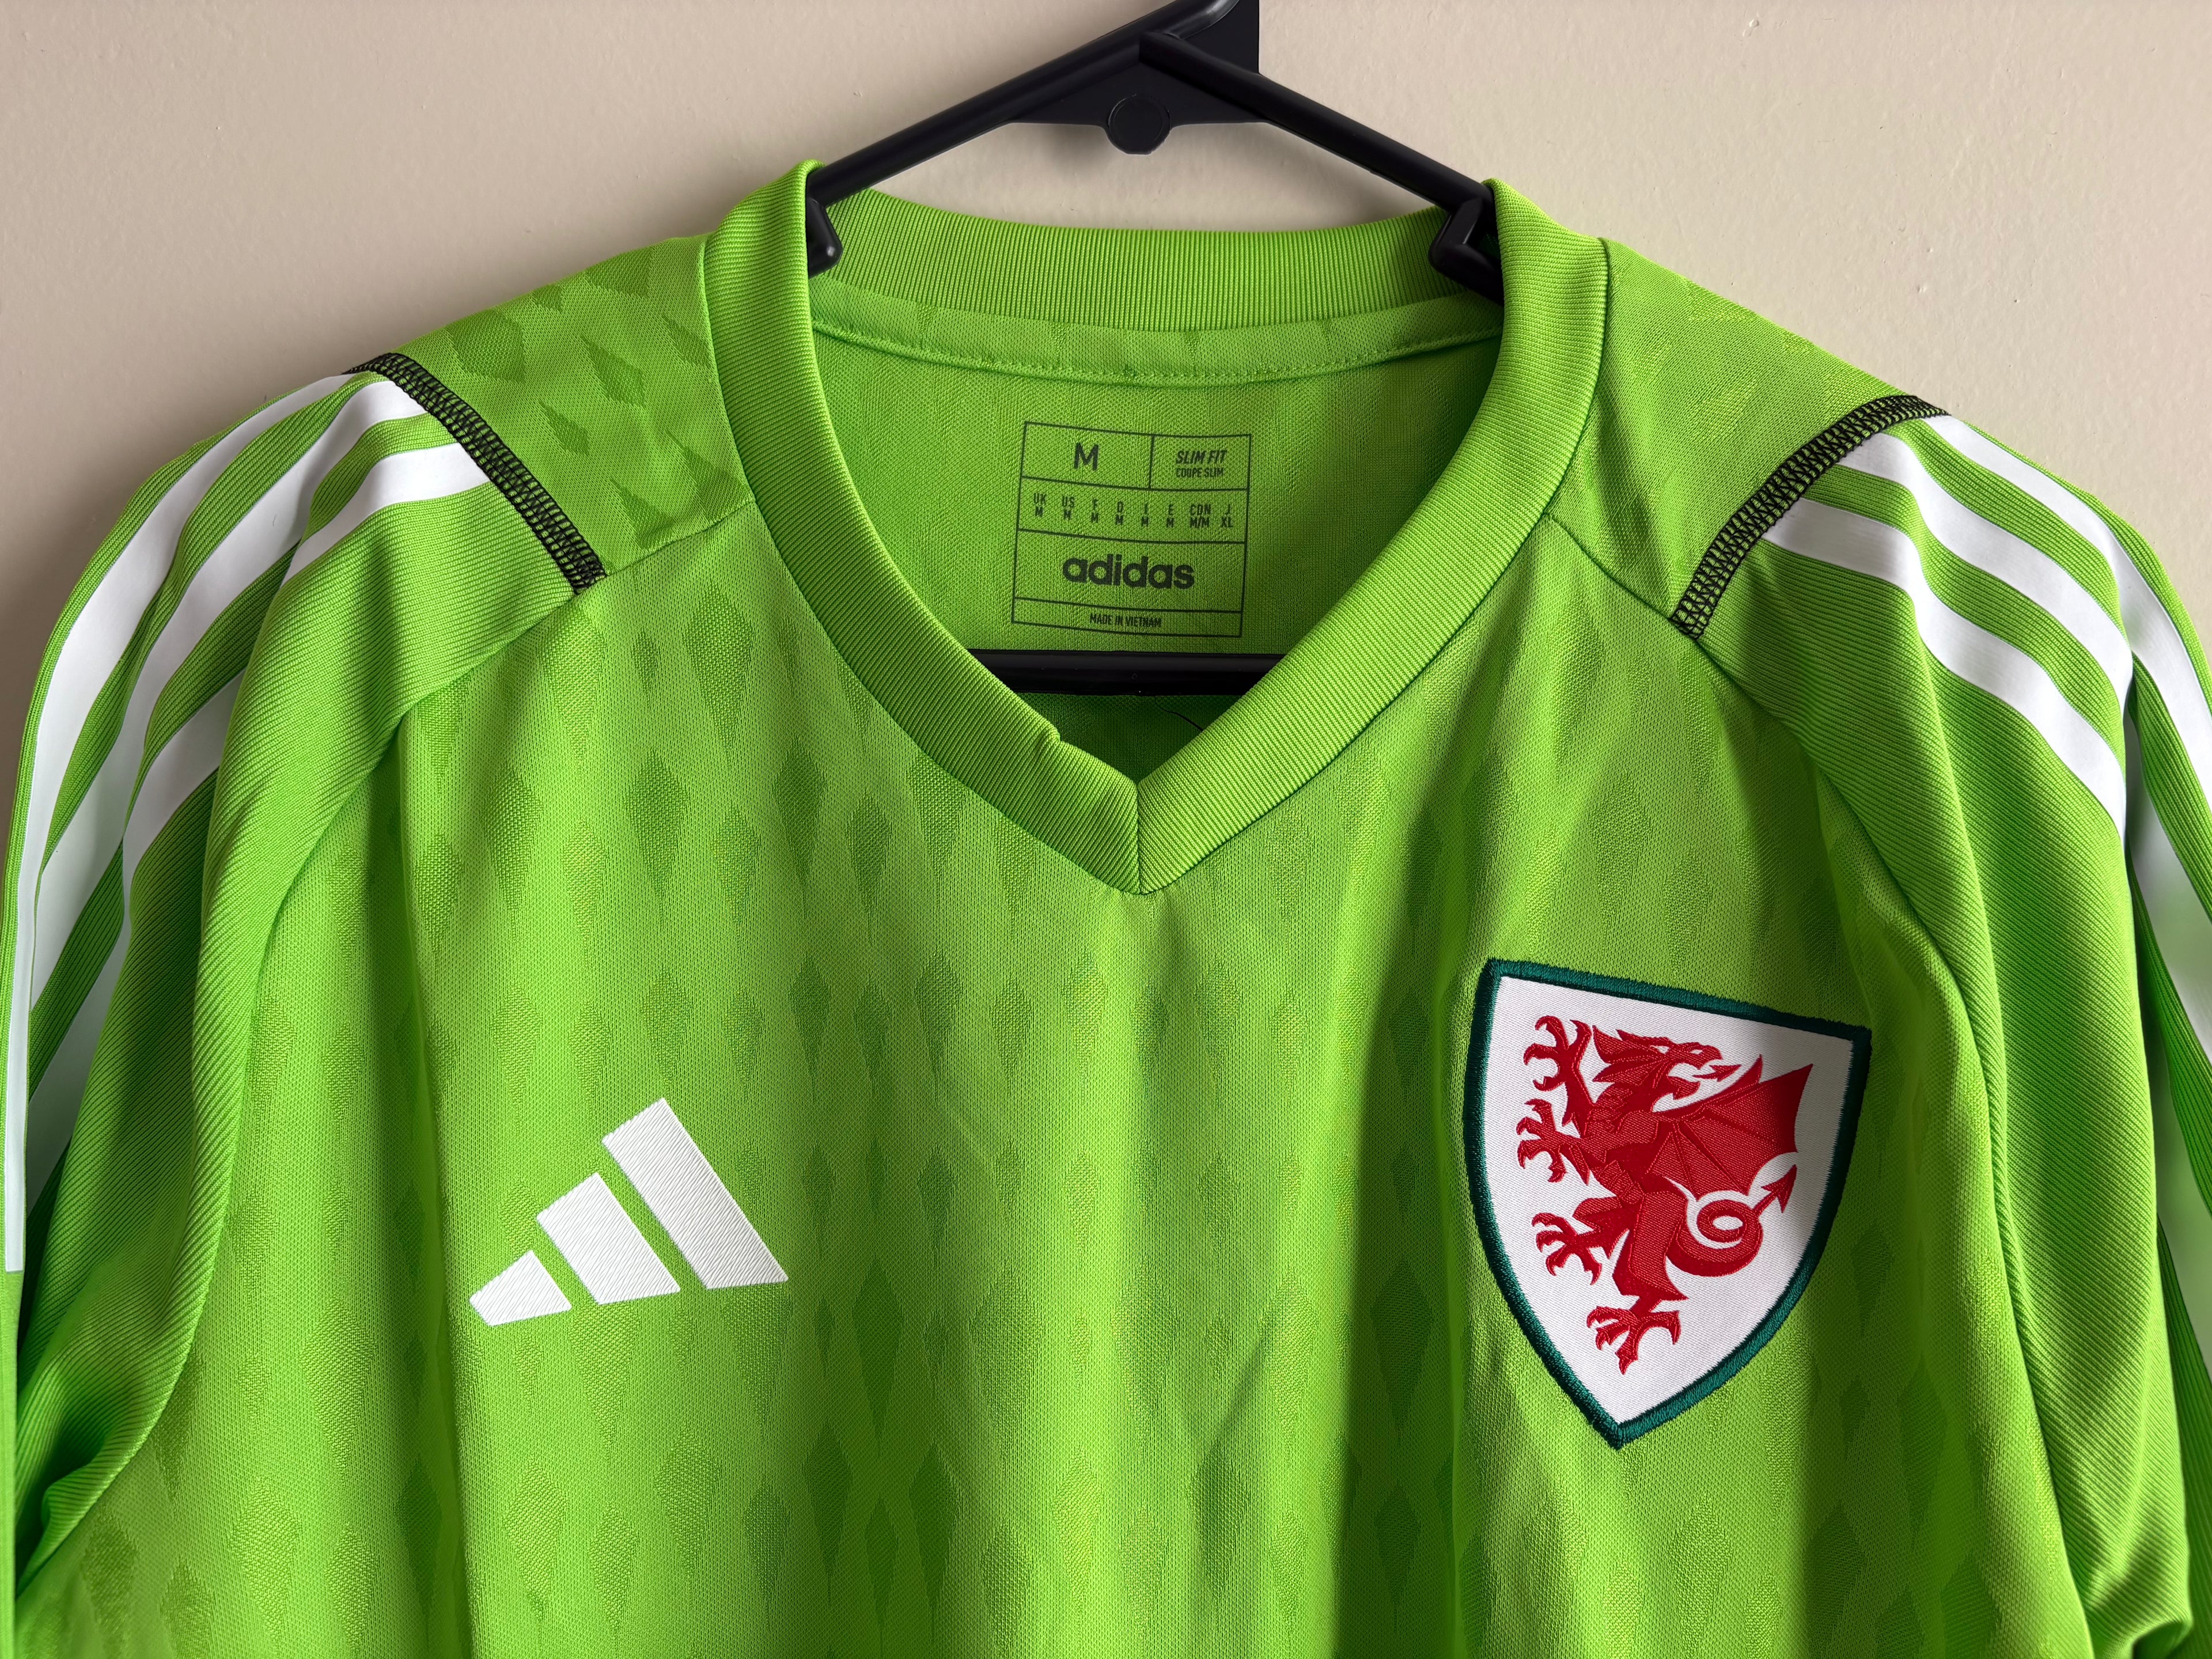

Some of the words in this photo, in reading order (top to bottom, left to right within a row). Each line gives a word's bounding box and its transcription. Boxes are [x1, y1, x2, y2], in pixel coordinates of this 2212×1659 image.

[1073, 443, 1099, 470] M
[1176, 450, 1205, 463] SLIM
[1208, 450, 1226, 463] FIT
[1176, 468, 1202, 478] COUPE
[1205, 468, 1224, 476] SLIM
[1034, 493, 1046, 505] UK
[1062, 496, 1074, 507] US
[1093, 499, 1099, 510] F
[1169, 505, 1173, 516] E
[1035, 506, 1043, 517] M
[1063, 510, 1071, 520] M
[1091, 513, 1099, 523] M
[1116, 514, 1123, 525] M
[1141, 516, 1149, 527] M
[1166, 517, 1174, 528] M
[1221, 517, 1233, 528] XL
[1063, 554, 1195, 589] adidas
[1090, 612, 1112, 624] MADE
[1115, 615, 1123, 626] IN
[1126, 616, 1161, 627] VIETNAM
